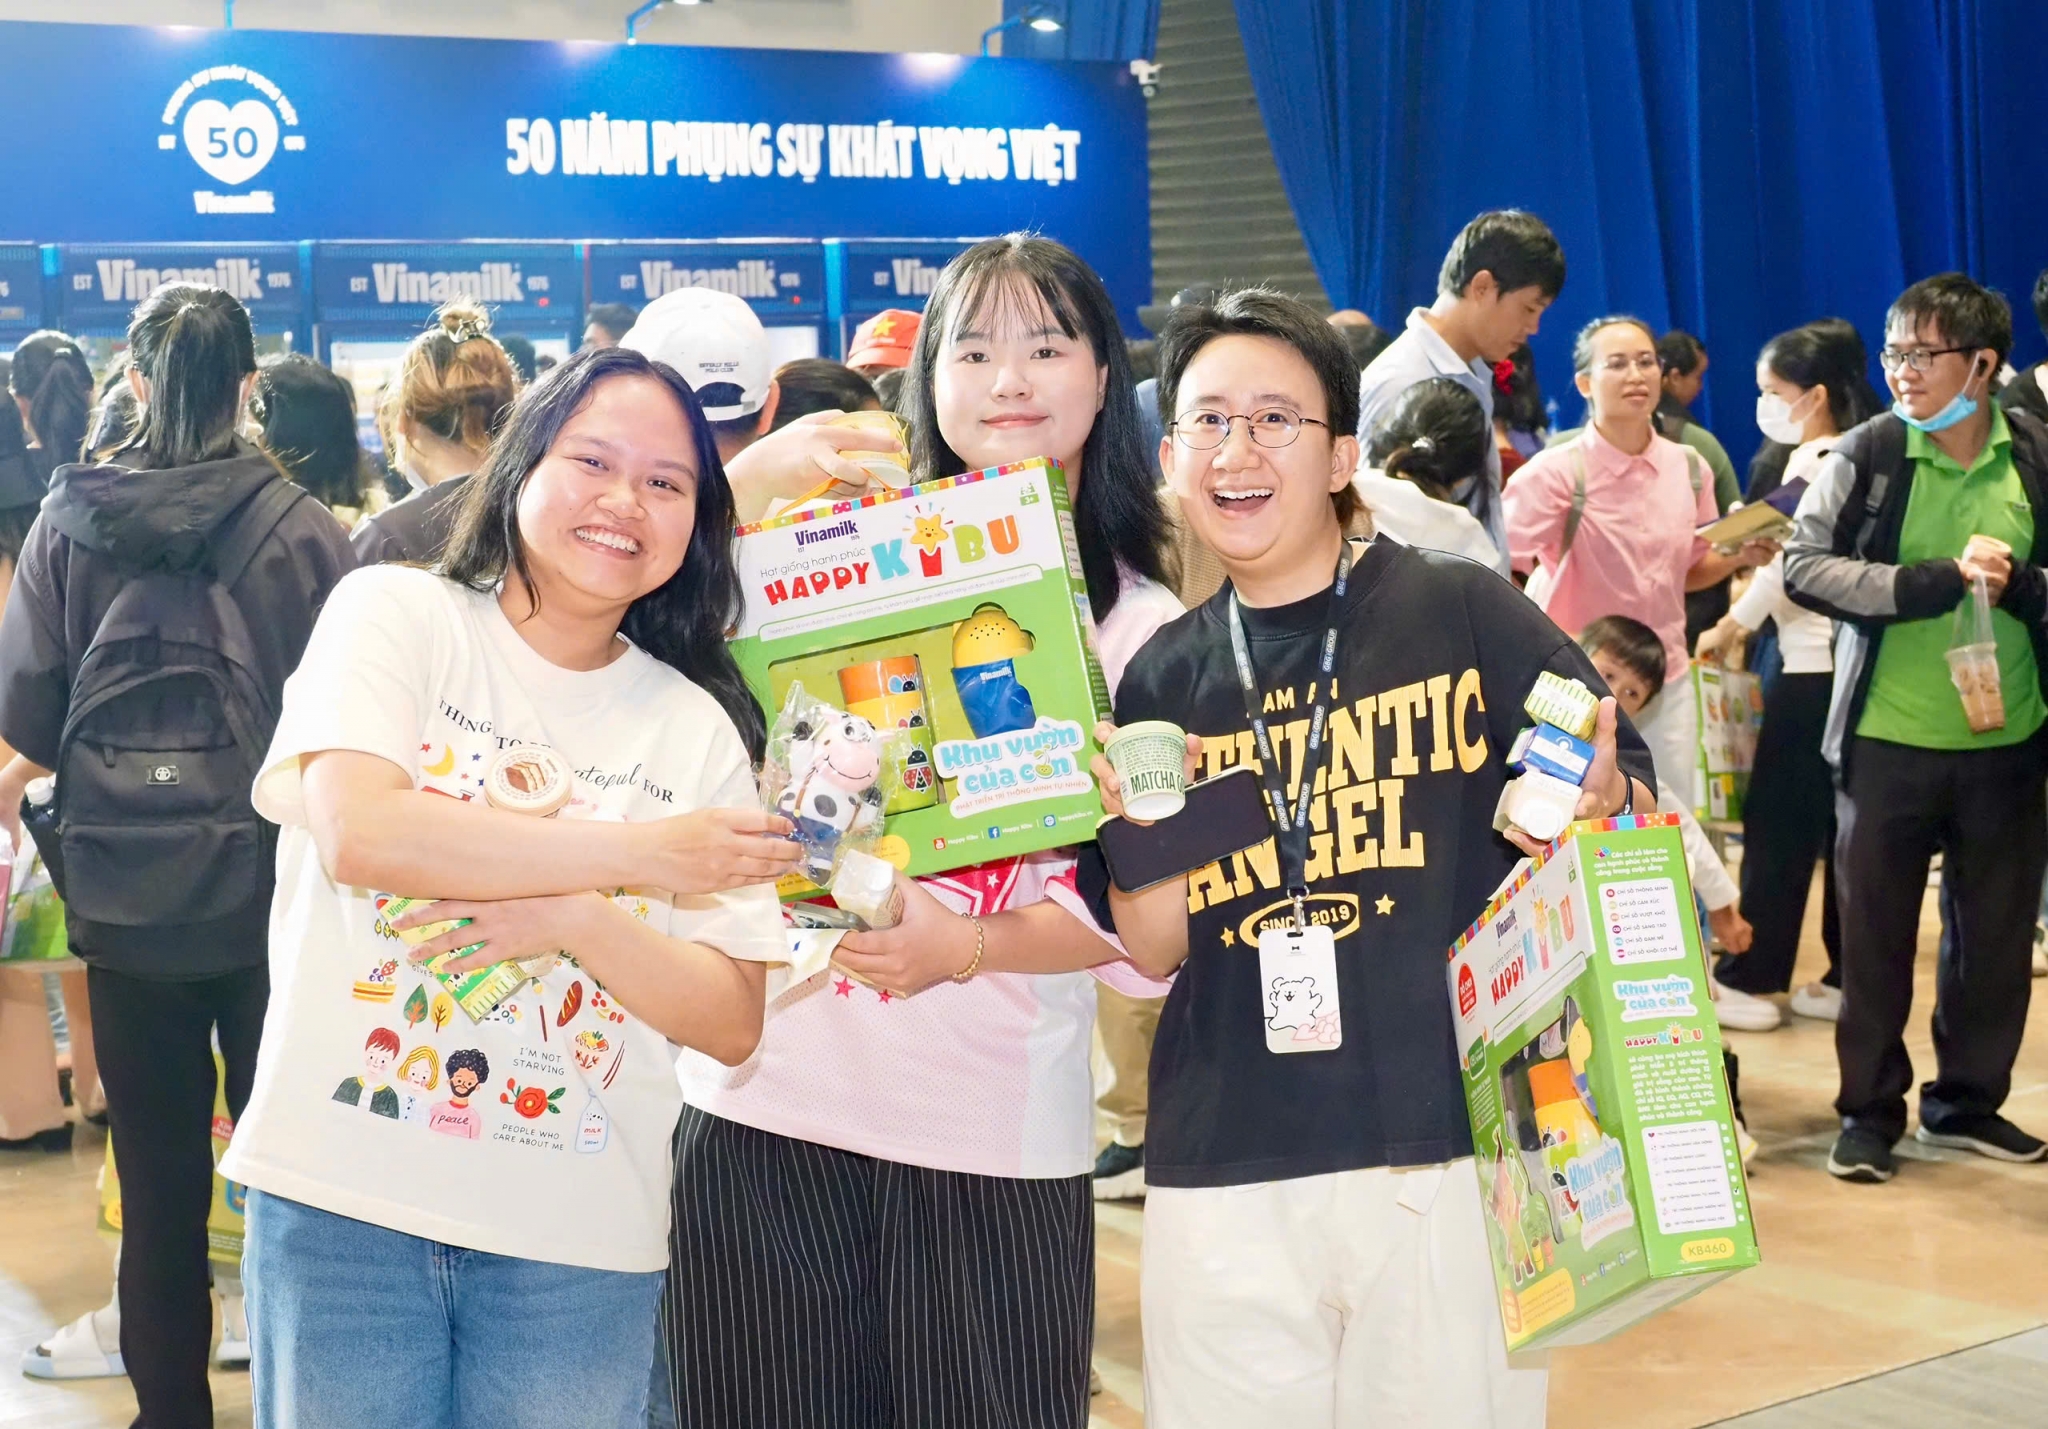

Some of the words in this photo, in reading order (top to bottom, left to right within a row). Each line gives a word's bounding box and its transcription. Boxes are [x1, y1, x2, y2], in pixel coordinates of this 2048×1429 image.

[208, 126, 258, 159] 50
[506, 118, 556, 175] 50
[560, 111, 648, 175] NĂM
[651, 120, 773, 182] PHỤNG
[776, 123, 824, 184] SỰ
[828, 119, 917, 179] KHÁT
[918, 126, 1009, 185] VỌNG
[1009, 122, 1081, 187] VIỆT
[73, 275, 92, 290] EST
[350, 277, 368, 293] EST
[372, 262, 524, 303] Vinamilk
[620, 274, 638, 289] EST
[892, 259, 943, 296] Vin
[795, 520, 858, 546] Vinamilk
[760, 567, 779, 579] Hạt
[780, 559, 809, 576] giống
[839, 547, 866, 561] phúc
[1338, 558, 1350, 579] GROUP
[764, 562, 870, 606] HAPPY
[1326, 628, 1337, 655] GROUP
[1322, 654, 1334, 672] GBG
[1263, 687, 1295, 713] AM
[439, 697, 496, 734] THING
[1313, 705, 1325, 732] GROUP
[940, 742, 1002, 770] Khu
[1005, 722, 1078, 755] vườn
[1258, 735, 1271, 759] GROUP
[1309, 732, 1320, 749] GBG
[574, 763, 642, 790] ateful
[643, 779, 674, 803] FOR
[964, 764, 1018, 794] của
[1033, 783, 1052, 792] MINH
[1130, 770, 1176, 795] MATCHA
[1299, 783, 1310, 809] GROUP
[1276, 805, 1290, 831] GROUP
[1296, 809, 1306, 827] GBG
[1260, 914, 1297, 931] SINC
[1310, 904, 1351, 926] 2019
[1491, 955, 1524, 1006] HAPPY
[1617, 983, 1649, 996] Khu
[512, 1058, 565, 1076] STARVING
[519, 1047, 538, 1057] I'M
[541, 1052, 562, 1063] NOT
[437, 1114, 469, 1125] peace
[502, 1123, 535, 1136] PEOPLE
[539, 1130, 560, 1140] WHO
[493, 1132, 516, 1143] CARE
[519, 1133, 549, 1148] ABOUT
[551, 1143, 564, 1151] ME
[1688, 1243, 1727, 1257] KB460
